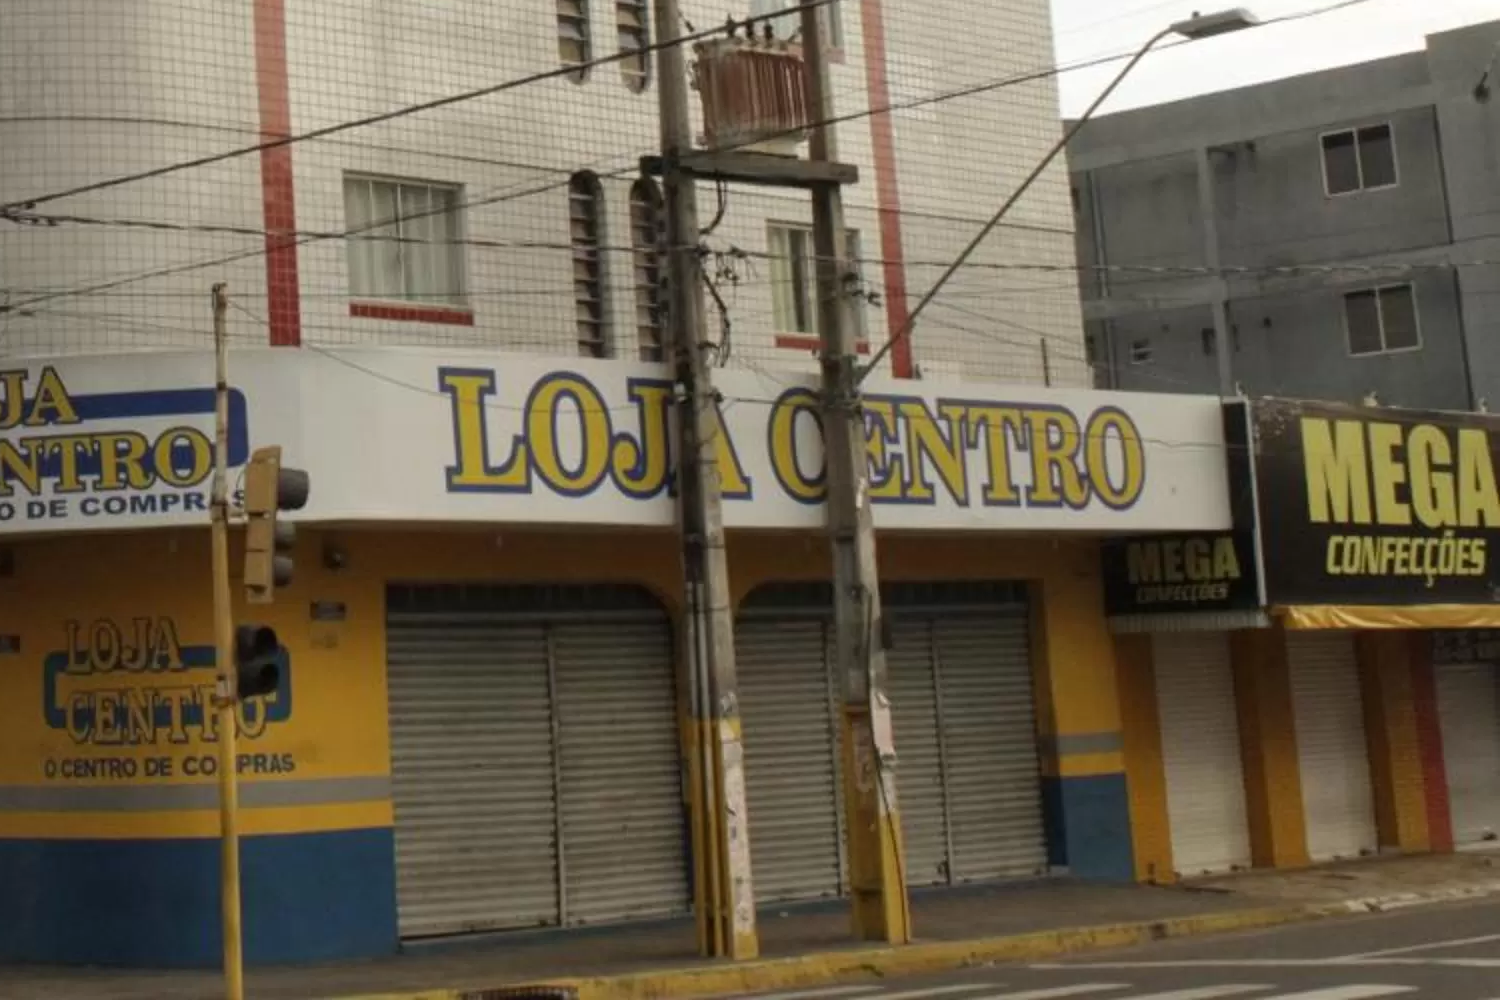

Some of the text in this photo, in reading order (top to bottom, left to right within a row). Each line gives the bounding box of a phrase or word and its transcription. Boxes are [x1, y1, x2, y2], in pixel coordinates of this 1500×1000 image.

[1301, 416, 1500, 528] MEGA
[26, 499, 68, 520] DE
[79, 489, 246, 517] COMPRS
[1126, 537, 1241, 585] MEGA
[1326, 531, 1486, 589] CONFECÇÕES
[63, 615, 185, 676] LOJA
[60, 756, 137, 780] CENTRO
[143, 756, 173, 778] DE
[181, 752, 297, 777] COPRAS
